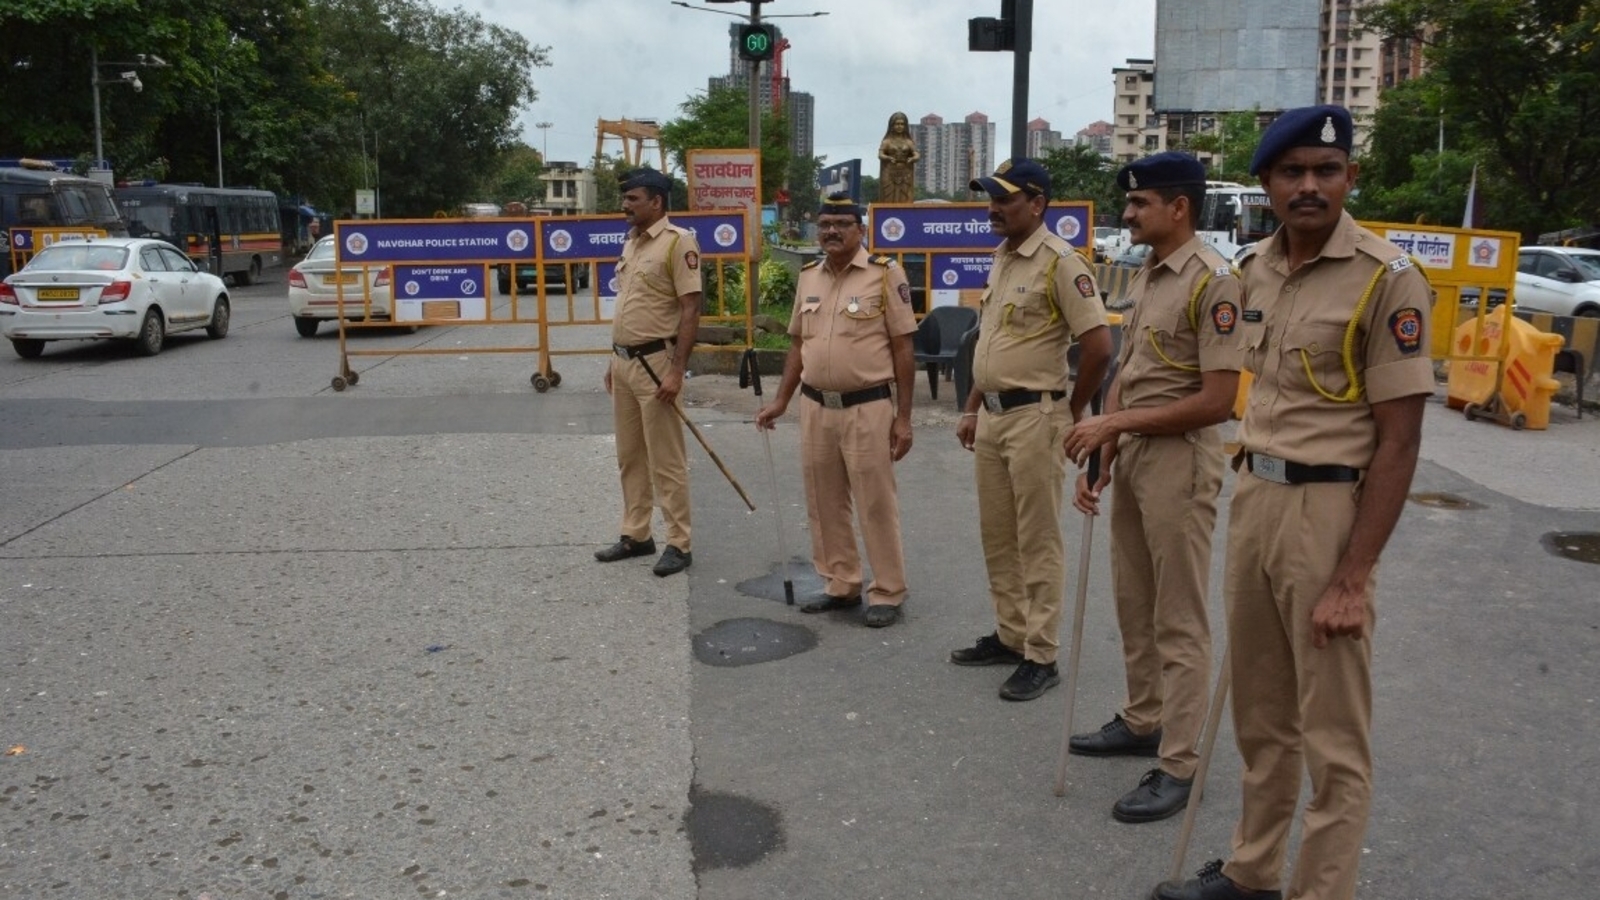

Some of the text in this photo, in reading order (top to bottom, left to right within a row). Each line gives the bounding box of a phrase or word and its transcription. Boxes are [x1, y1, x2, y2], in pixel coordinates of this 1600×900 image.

[747, 34, 767, 51] GO
[694, 161, 754, 178] सावधान
[923, 222, 962, 234] नवघर
[377, 237, 498, 248] NAVGHAR POLICE STATION
[589, 231, 625, 245] नवघर
[1417, 234, 1451, 256] पोलीस
